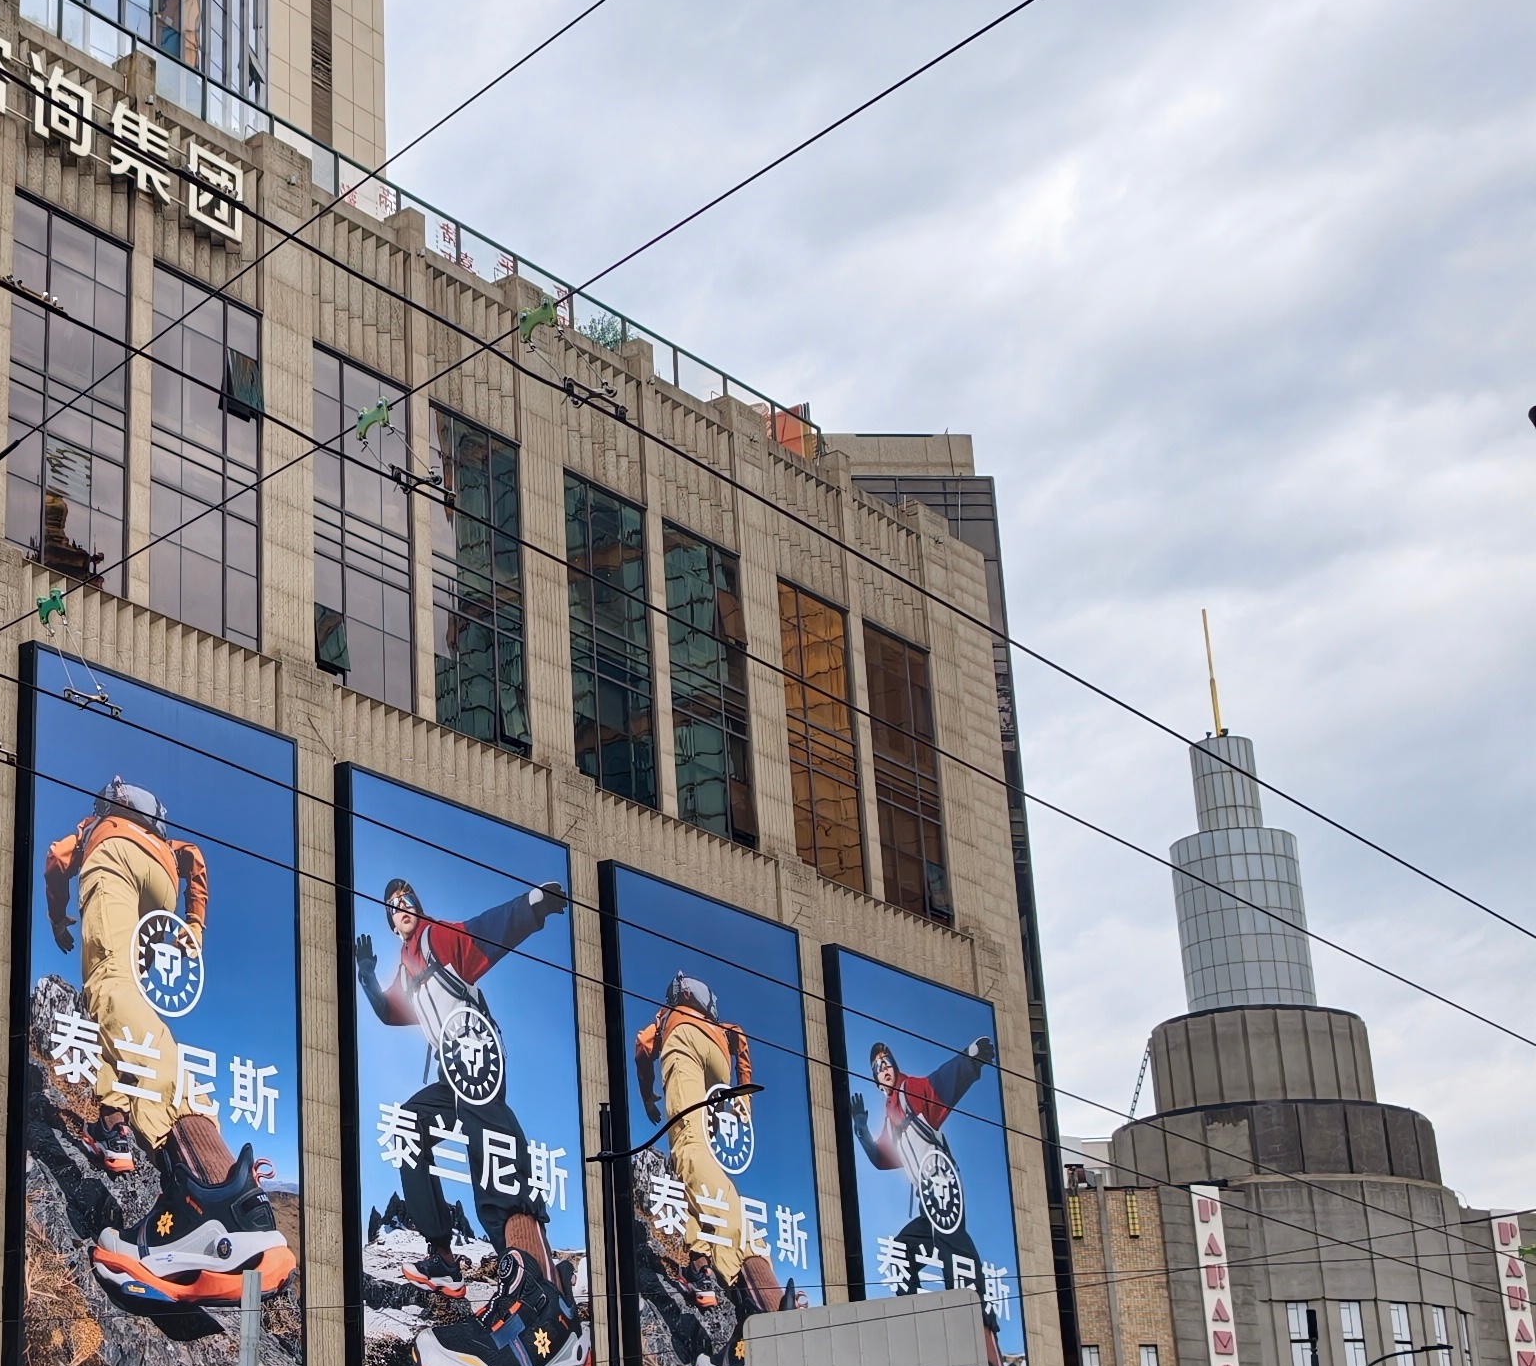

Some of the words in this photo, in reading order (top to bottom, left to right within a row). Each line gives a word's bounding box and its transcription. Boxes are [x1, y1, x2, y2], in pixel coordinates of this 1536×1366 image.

[51, 1010, 280, 1135] 泰兰尼斯
[375, 1101, 570, 1212] 泰兰尼斯
[648, 1173, 810, 1272] 泰兰尼斯
